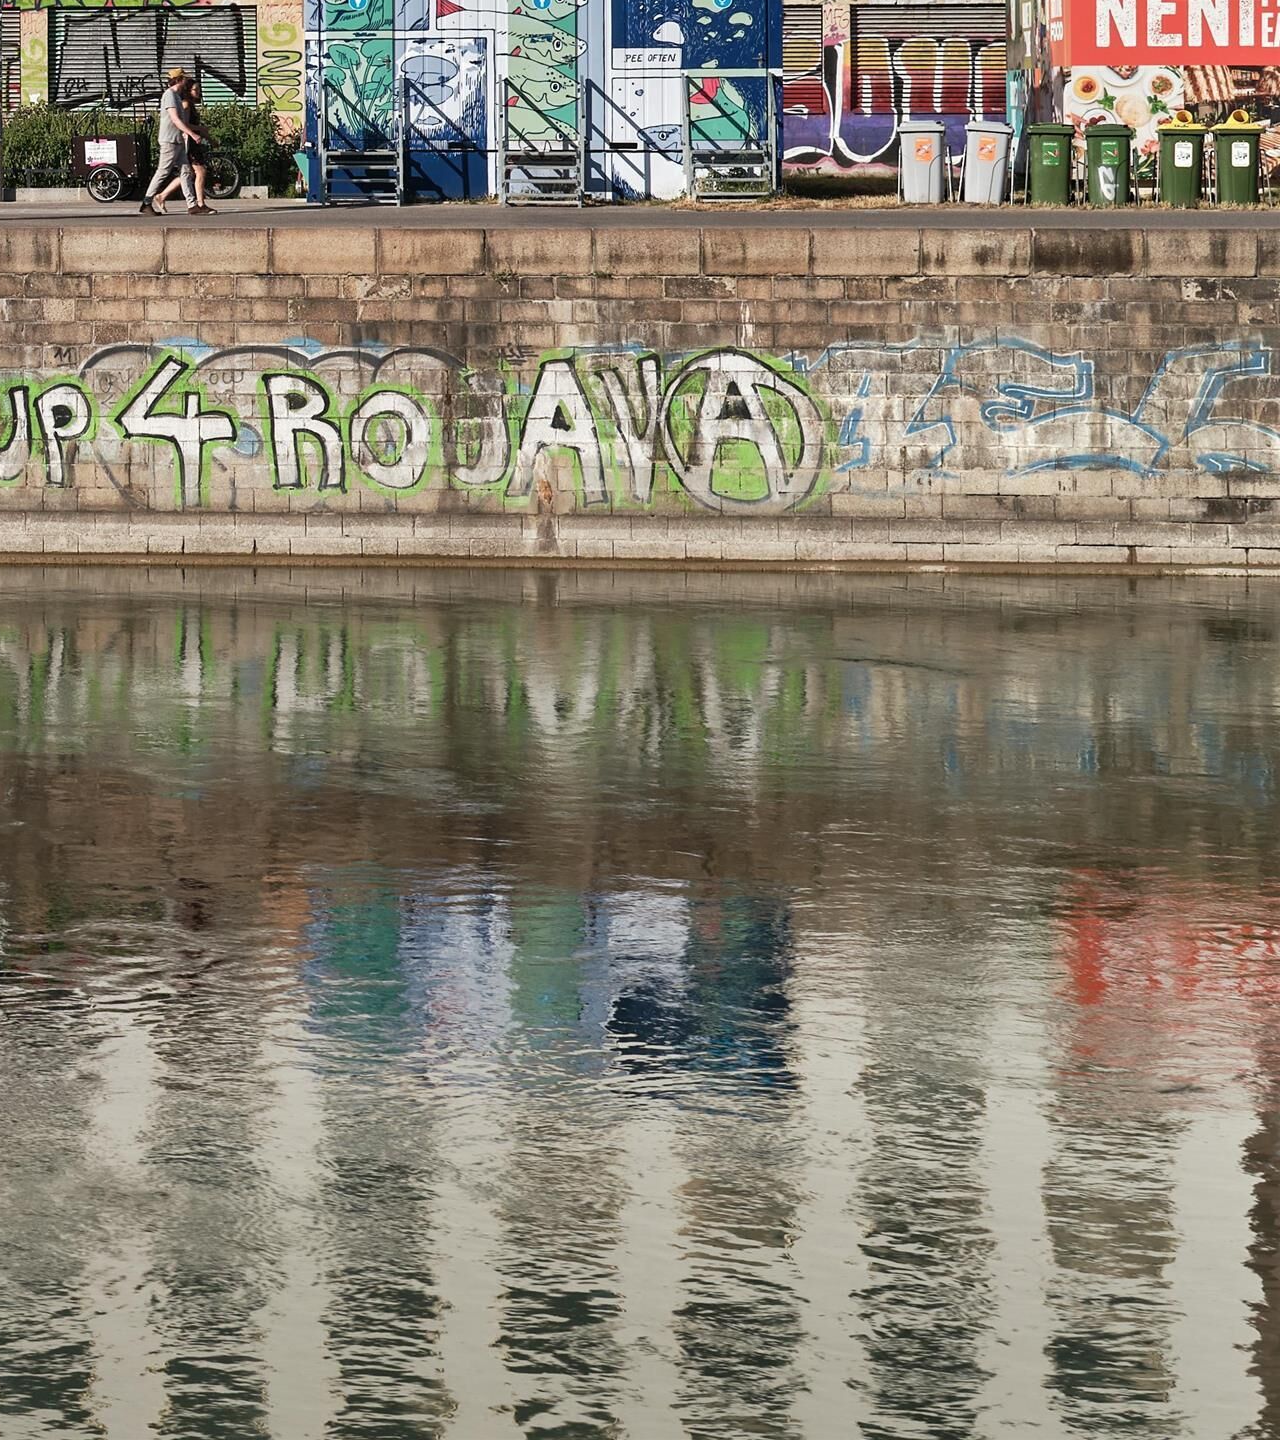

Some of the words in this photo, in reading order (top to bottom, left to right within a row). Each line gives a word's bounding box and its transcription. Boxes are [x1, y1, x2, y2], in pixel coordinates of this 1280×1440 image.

[625, 54, 642, 63] PEE
[647, 53, 677, 63] OFTEN
[115, 354, 237, 507] 4
